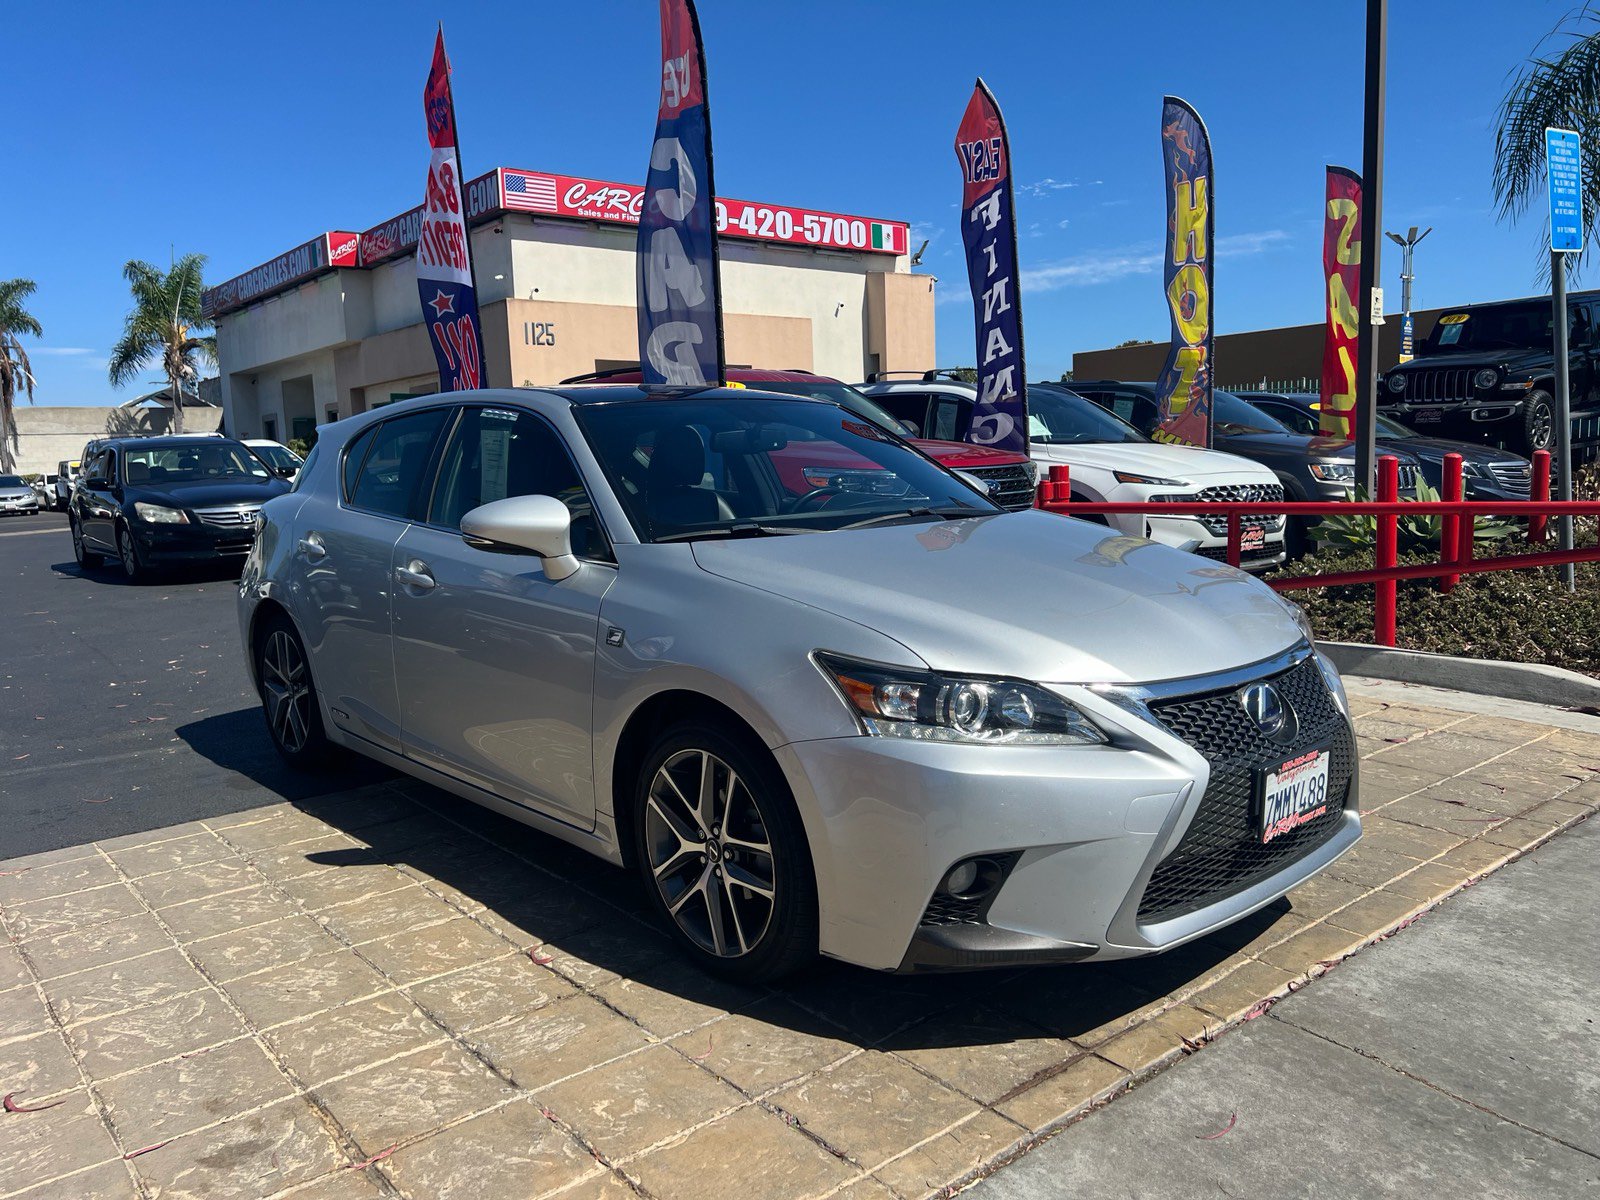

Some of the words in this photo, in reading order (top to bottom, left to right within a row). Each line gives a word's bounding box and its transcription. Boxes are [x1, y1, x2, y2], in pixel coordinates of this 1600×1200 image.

[578, 208, 602, 218] Sales
[604, 212, 620, 220] and
[331, 239, 357, 260] CARCO
[237, 246, 311, 300] CARCOSALES.COM
[1168, 176, 1209, 416] HOT
[524, 322, 555, 346] 1125
[1267, 773, 1326, 824] 7MMY488
